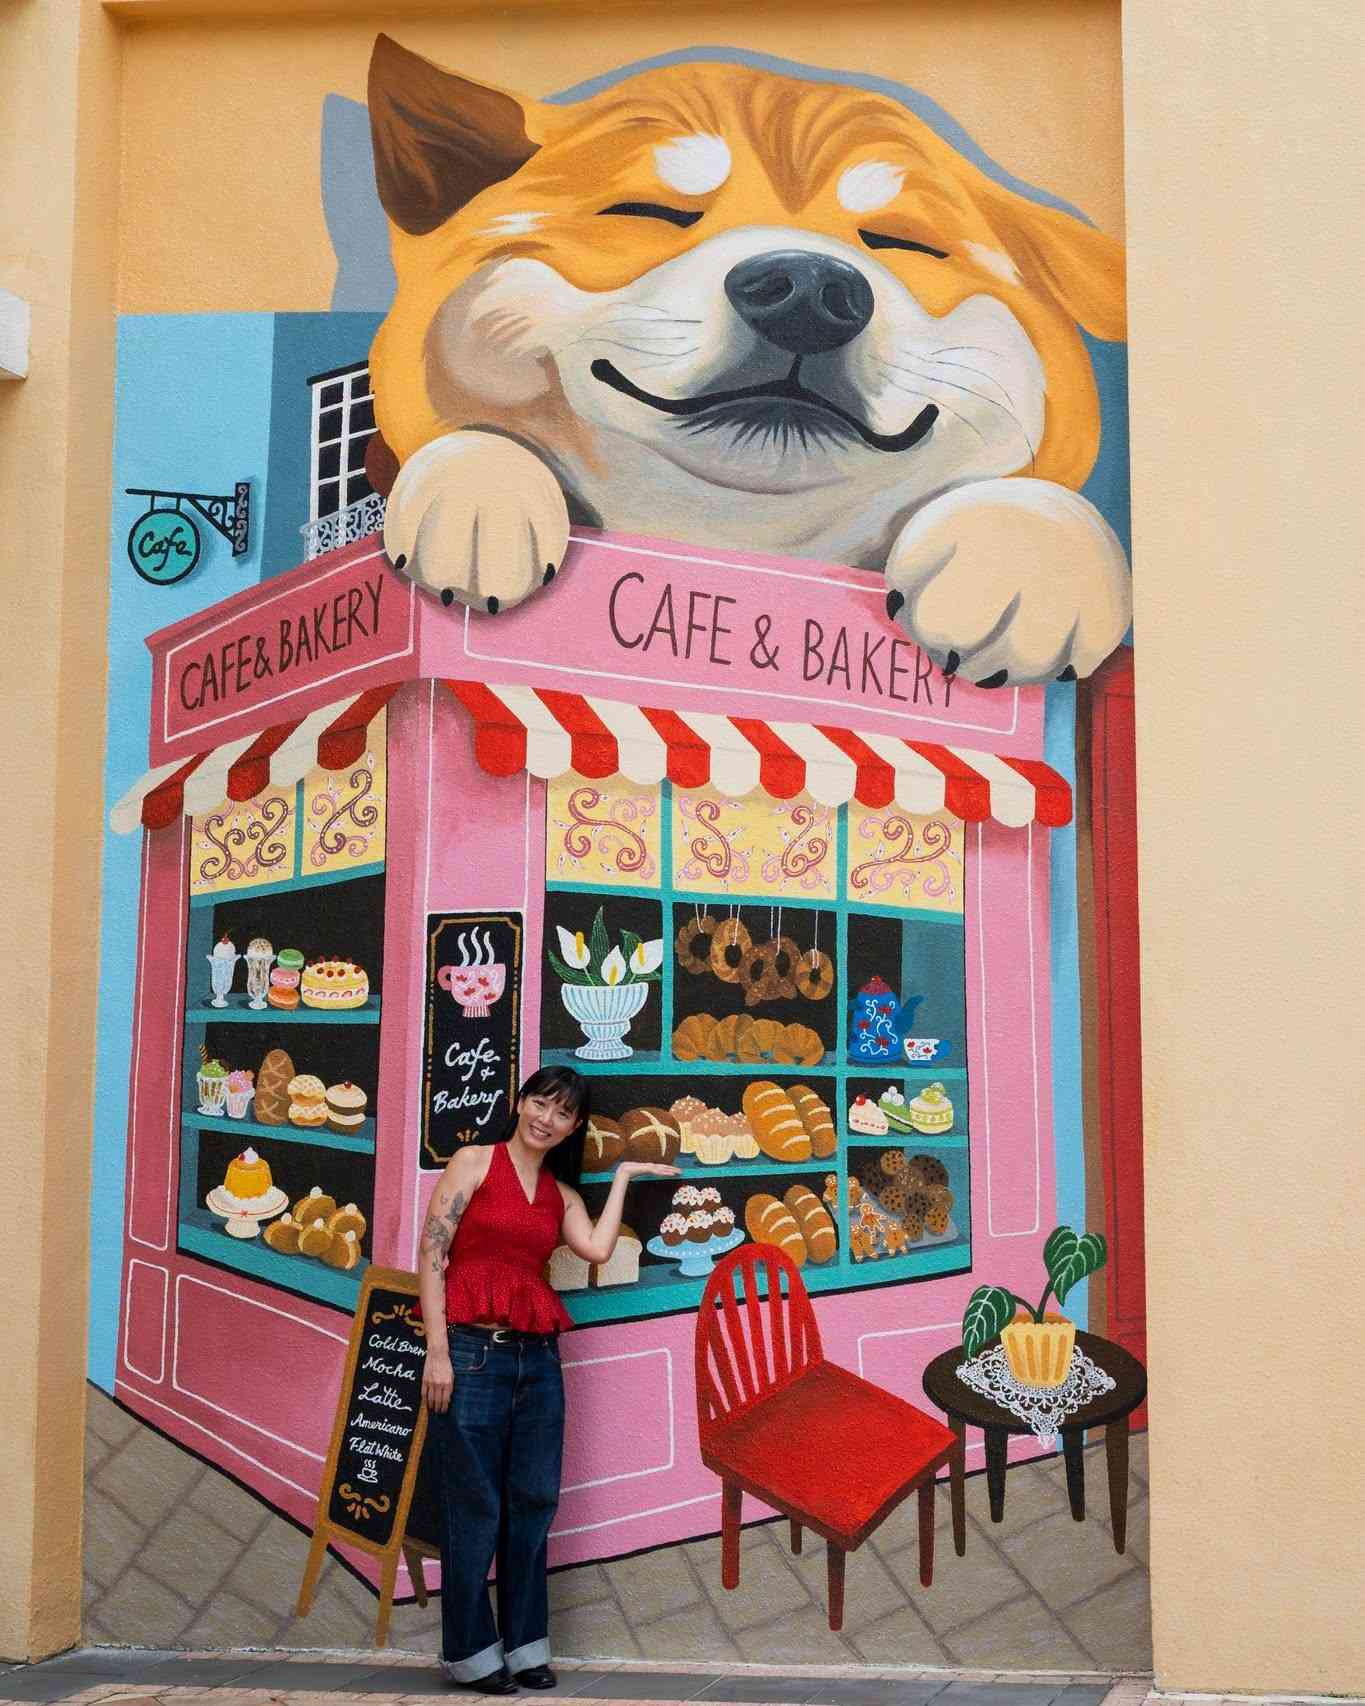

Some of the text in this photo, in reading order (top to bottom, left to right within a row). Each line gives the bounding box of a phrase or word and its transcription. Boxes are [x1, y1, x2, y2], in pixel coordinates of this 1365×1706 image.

[138, 526, 192, 572] Cafe
[279, 573, 384, 674] BAKERY
[608, 571, 737, 666] CAFE
[749, 613, 780, 672] &
[444, 1037, 501, 1082] Cafe
[433, 1086, 504, 1126] Bakery
[368, 1333, 399, 1352] Cold
[363, 1356, 416, 1380] Mocha
[358, 1382, 412, 1411] Latte
[351, 1412, 412, 1436] Americano
